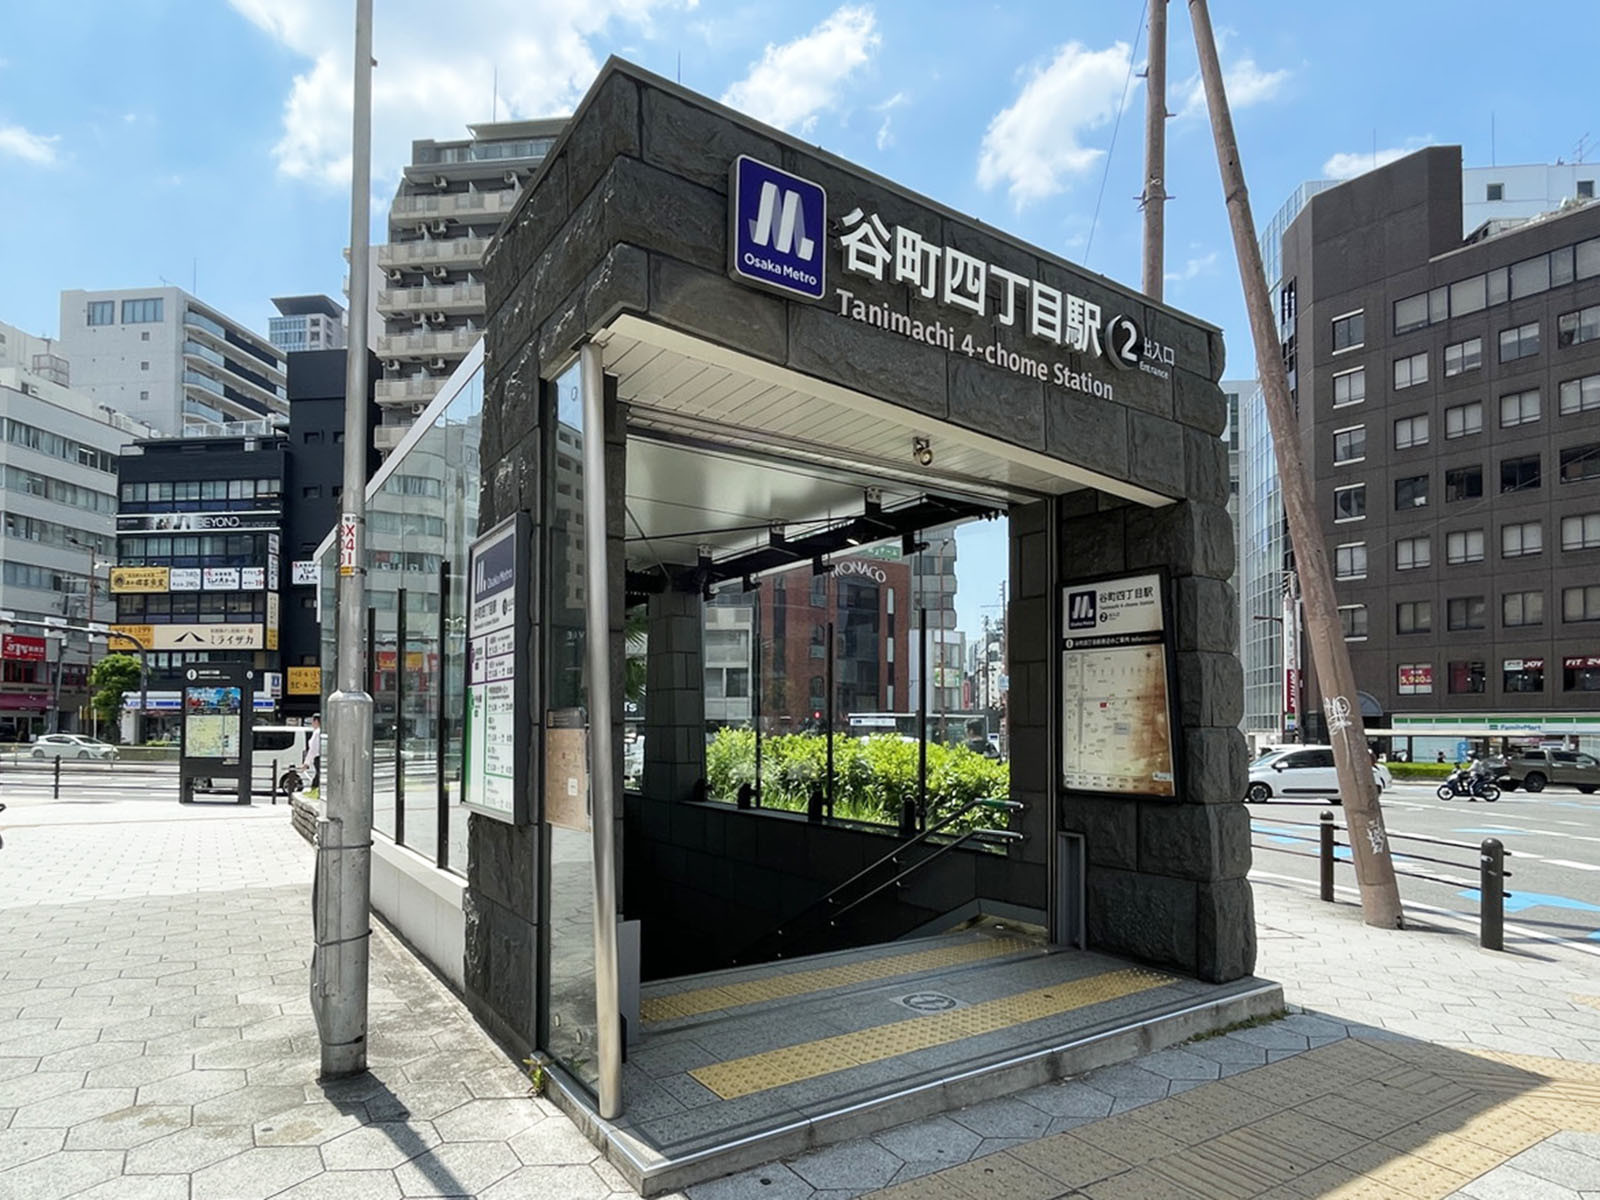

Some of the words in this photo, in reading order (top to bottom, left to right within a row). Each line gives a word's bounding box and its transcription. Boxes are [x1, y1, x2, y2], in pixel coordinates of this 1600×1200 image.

[744, 253, 781, 275] Osaka
[783, 265, 817, 286] Metro
[840, 207, 1102, 357] 谷町四丁目駅
[836, 288, 954, 352] Tanimachi
[961, 334, 1048, 380] 4-chome
[1054, 362, 1113, 400] Station
[1121, 320, 1138, 362] 2
[1143, 337, 1174, 367] 出入口
[1139, 361, 1169, 379] Entrance
[200, 516, 240, 528] BEYOND
[831, 561, 887, 583] MONACO
[1524, 660, 1544, 668] JOY
